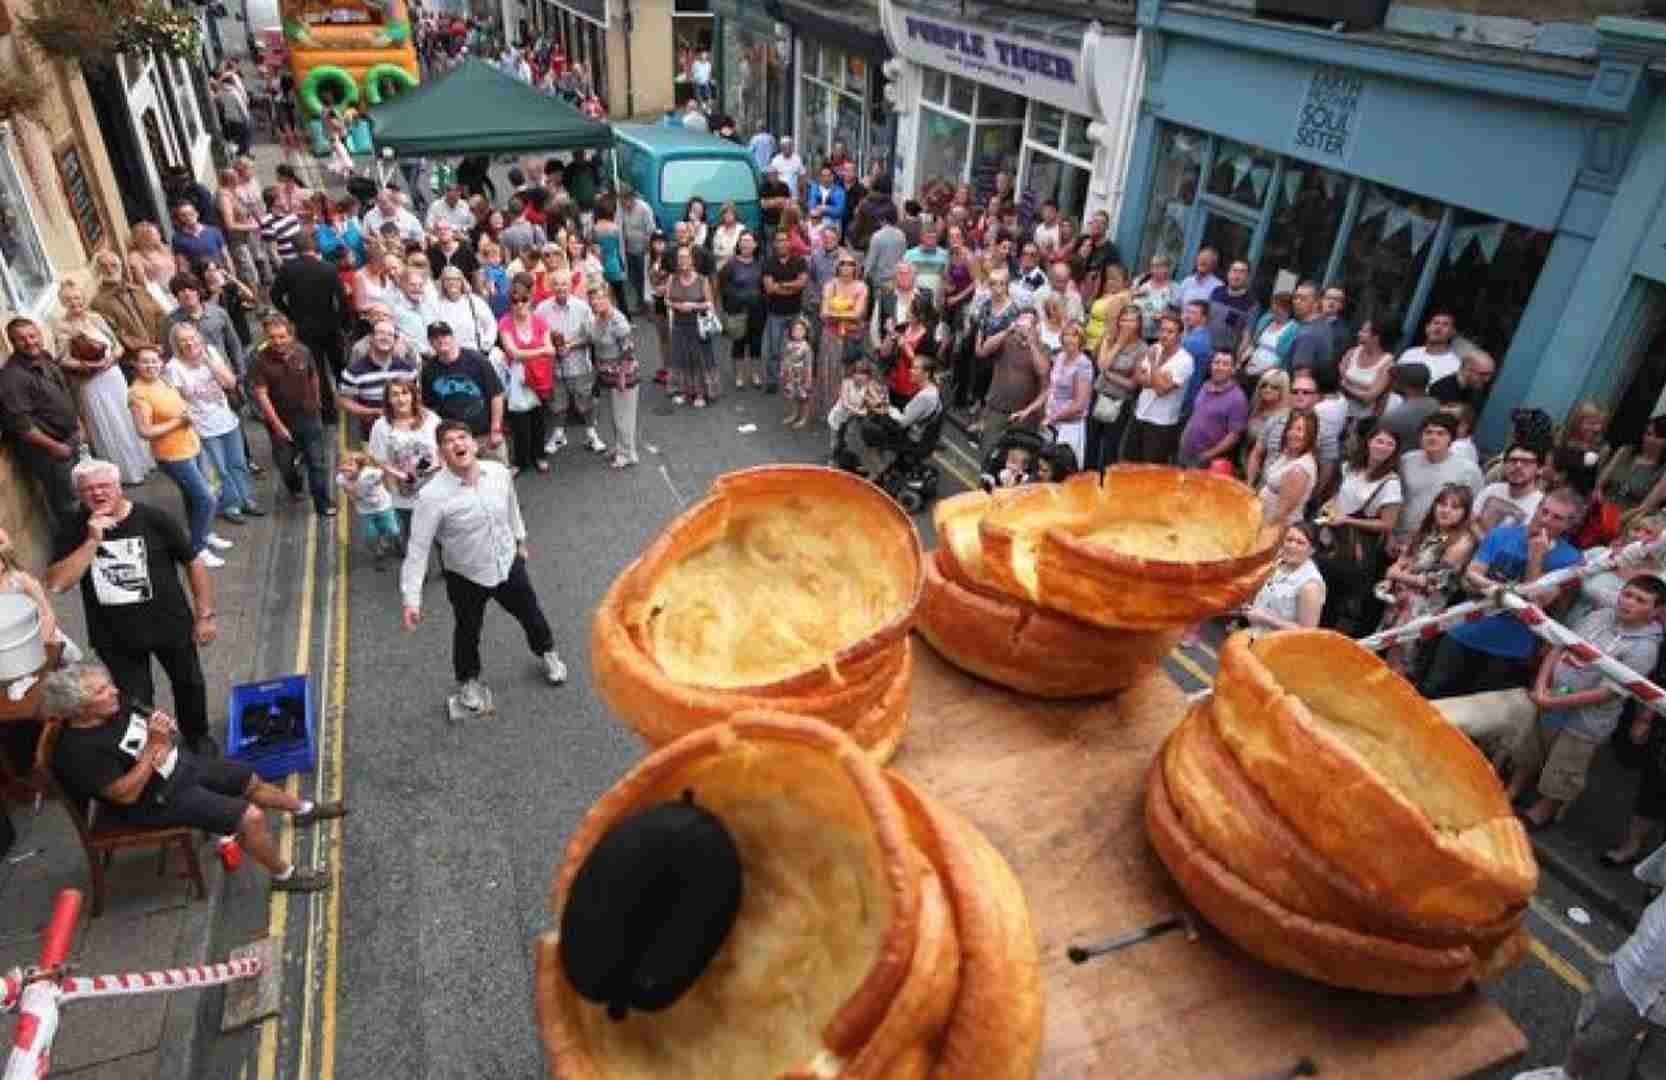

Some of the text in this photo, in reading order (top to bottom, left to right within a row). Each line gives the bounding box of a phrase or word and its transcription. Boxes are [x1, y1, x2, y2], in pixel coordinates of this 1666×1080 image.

[905, 16, 987, 58] PURPLE
[994, 38, 1076, 85] TIGER
[1301, 103, 1352, 133] SOUL
[1295, 126, 1347, 156] SISTER
